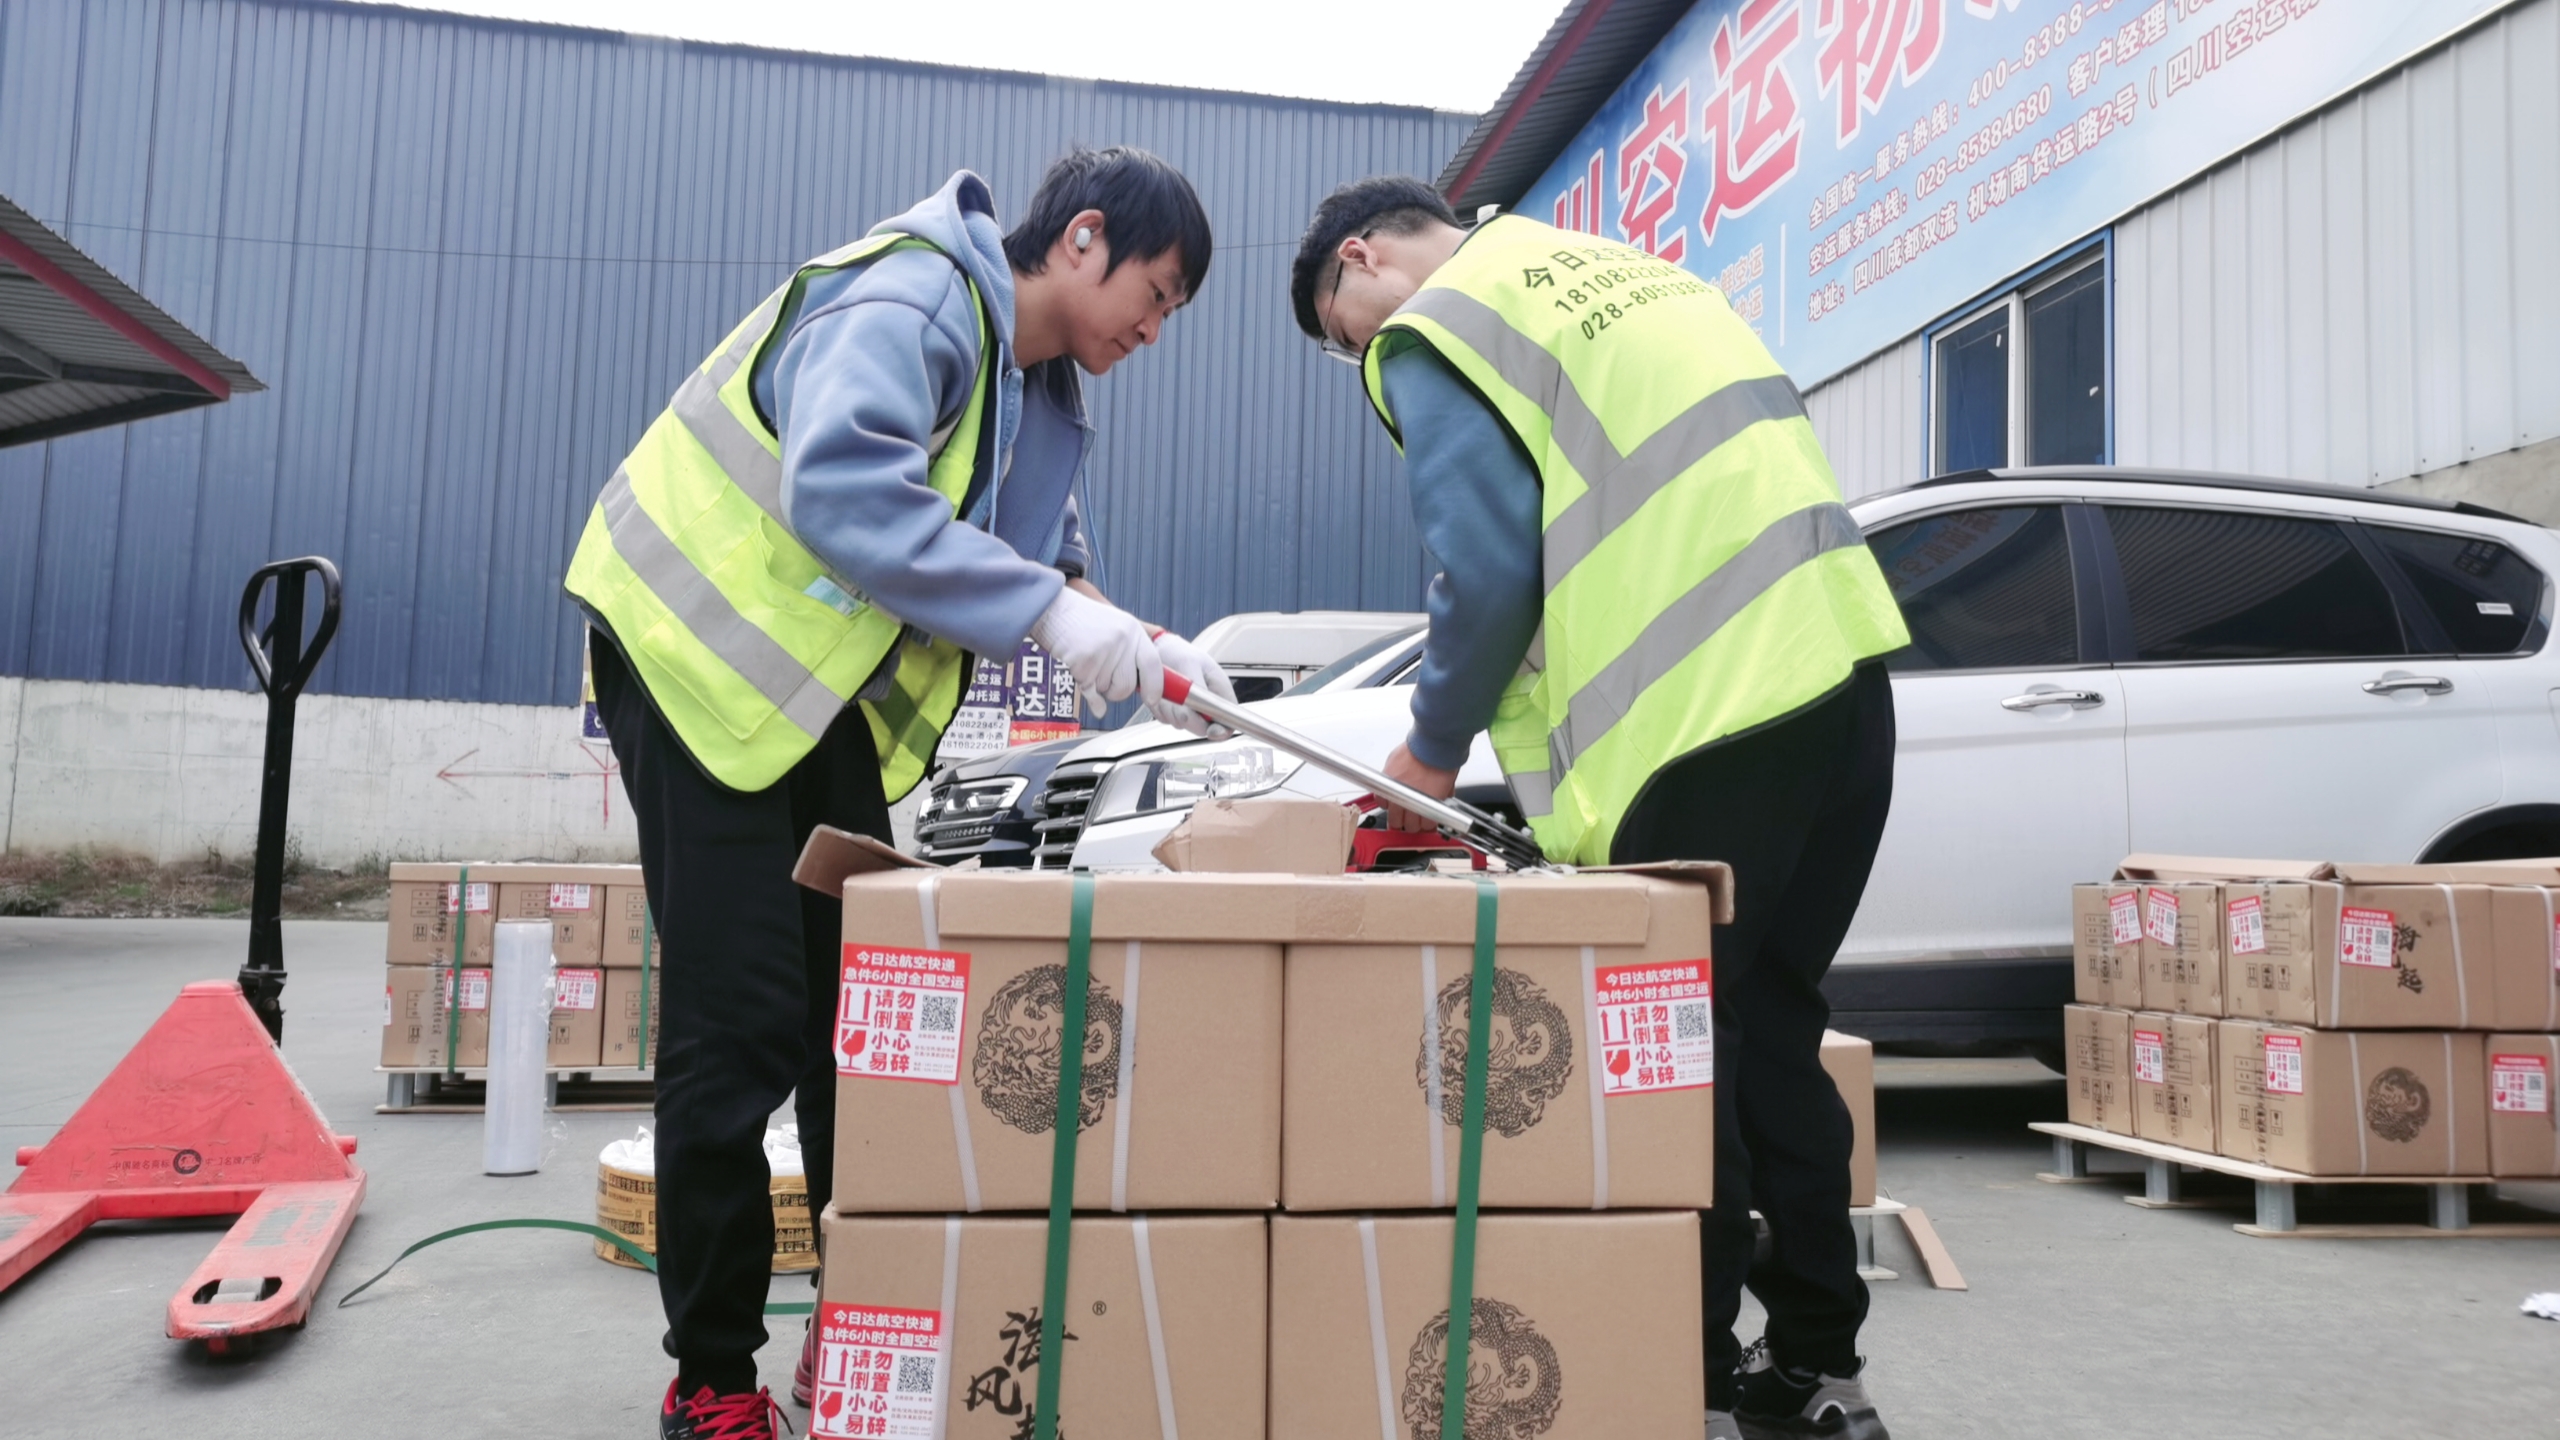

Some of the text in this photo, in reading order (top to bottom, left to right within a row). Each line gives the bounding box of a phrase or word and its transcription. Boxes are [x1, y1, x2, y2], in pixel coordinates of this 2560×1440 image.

[2067, 0, 2168, 99] 客户经理
[1553, 0, 2022, 266] 川空运物
[1709, 242, 1763, 300] 鲜空运
[951, 720, 1004, 729] 108229452
[856, 950, 956, 972] 今日达航空快递
[844, 966, 966, 990] 急件6小时全国空运
[1605, 966, 1699, 987] 今日达航空快递
[875, 989, 916, 1010] 请勿
[1597, 981, 1709, 1005] 急件6小时全国空运
[873, 1010, 914, 1032] 倒置
[1630, 1005, 1668, 1025] 请勿
[871, 1031, 911, 1052] 小心
[1633, 1025, 1671, 1045] 倒置
[869, 1052, 910, 1073] 易碎
[1635, 1045, 1673, 1066] 小心
[1637, 1065, 1675, 1086] 易碎
[833, 1310, 934, 1332] 今日达航空快递
[823, 1326, 941, 1349] 急件6小时全国空运
[851, 1349, 893, 1371] 请勿
[850, 1371, 890, 1393] 倒置
[847, 1393, 888, 1414] 小心
[845, 1414, 887, 1436] 易碎
